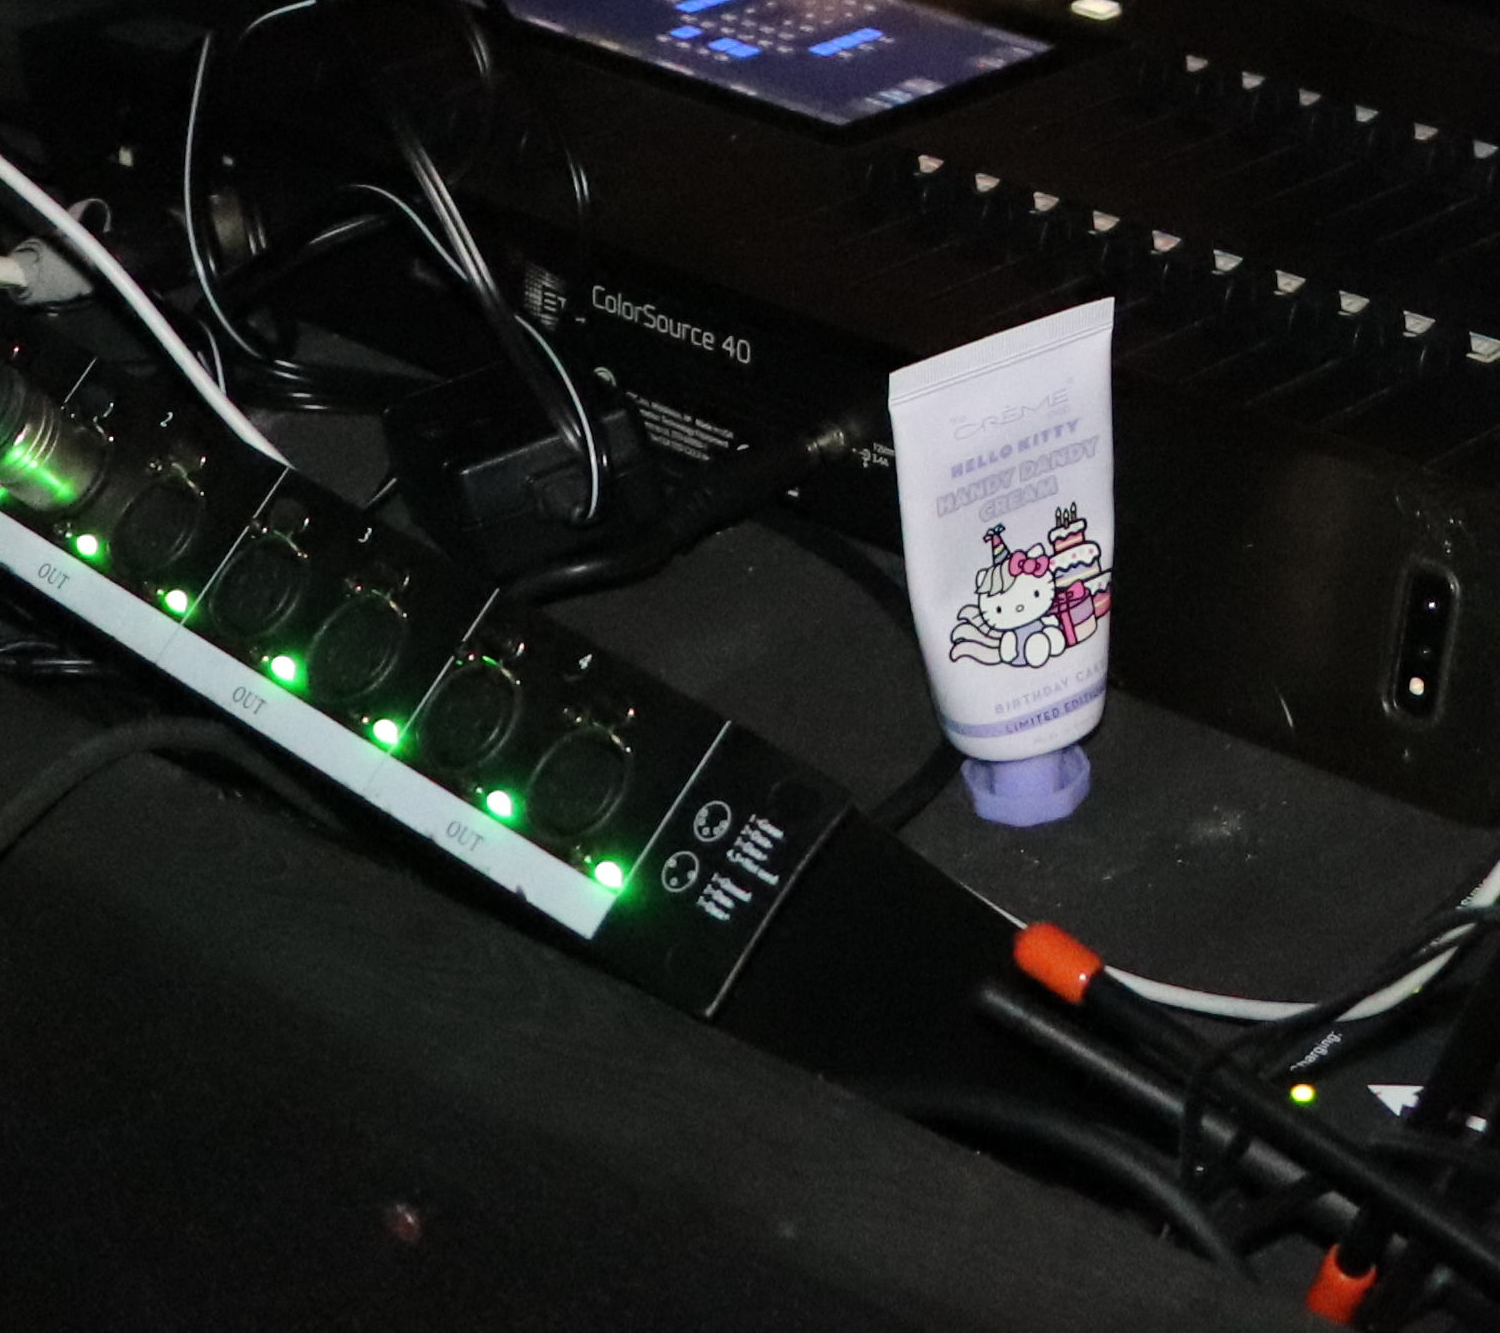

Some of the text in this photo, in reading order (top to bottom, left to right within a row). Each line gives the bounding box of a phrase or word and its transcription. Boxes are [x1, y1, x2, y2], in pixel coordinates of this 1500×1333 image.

[591, 284, 751, 365] ColorSource 40
[159, 411, 174, 428] 2
[951, 417, 1082, 479] HELLO KITTY
[936, 435, 1100, 518] HANDY DANDY
[978, 474, 1059, 523] CREAM
[37, 562, 70, 590] OUT
[232, 685, 267, 715] OUT
[1005, 707, 1060, 734] LIMITED
[447, 820, 484, 852] OUT
